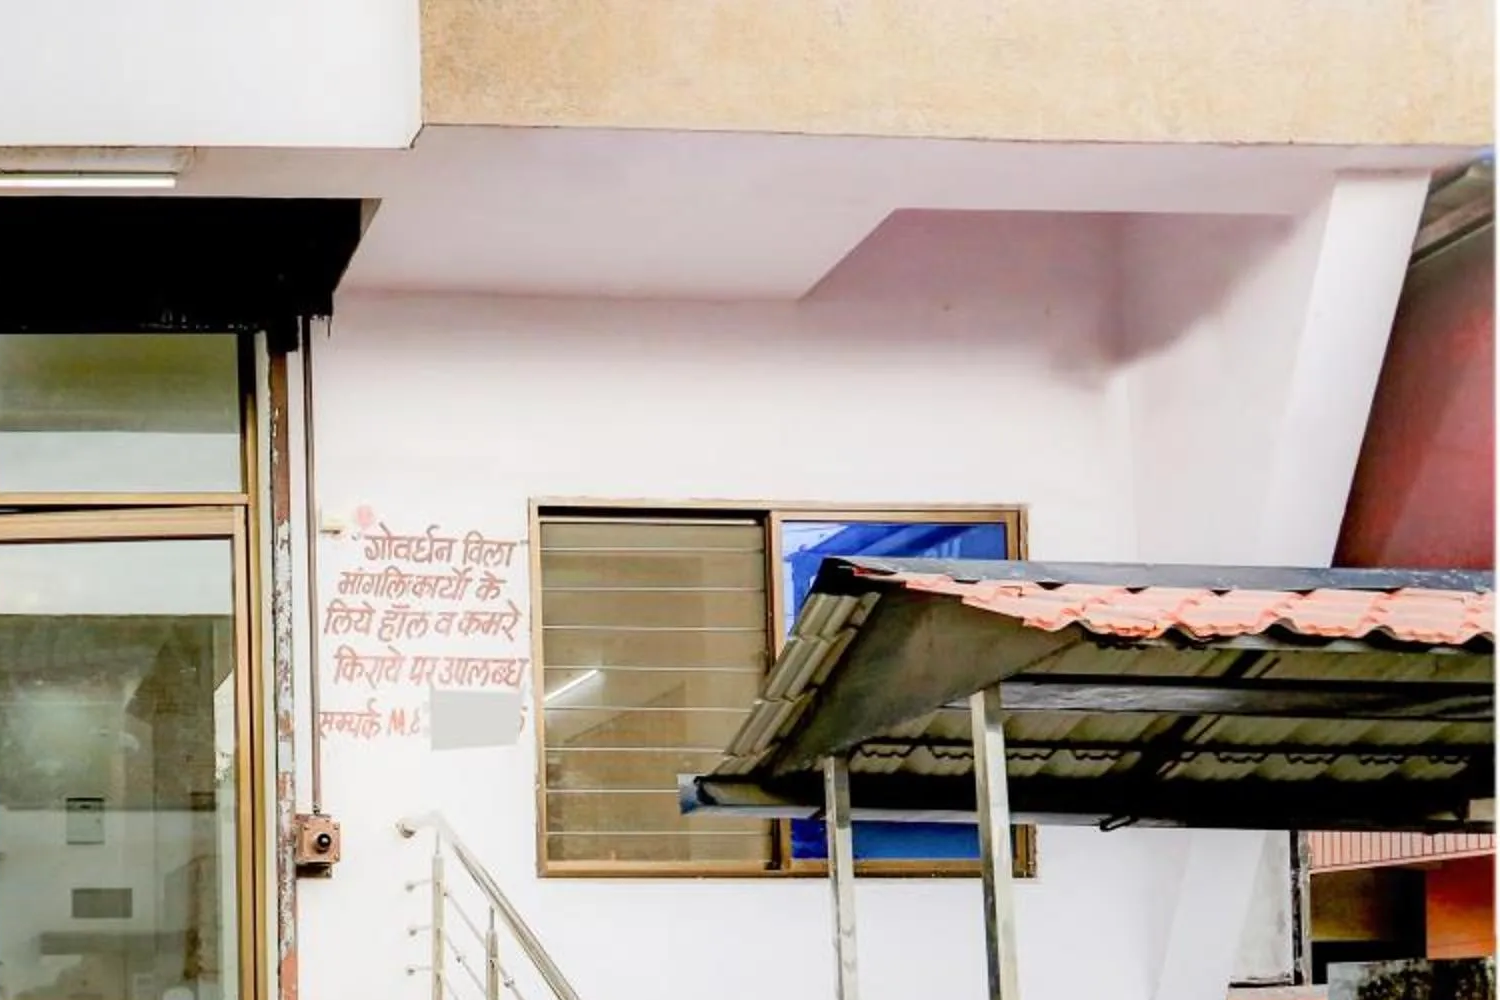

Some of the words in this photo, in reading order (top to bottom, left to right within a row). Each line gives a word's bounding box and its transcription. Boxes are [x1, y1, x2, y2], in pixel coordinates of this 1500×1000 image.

[364, 521, 459, 564] गोवर्धन
[462, 531, 518, 567] विला
[474, 571, 508, 600] के
[324, 598, 377, 636] लिये
[377, 604, 434, 642] हॉल
[458, 600, 523, 642] कमरे
[333, 645, 405, 689] किराये
[409, 656, 440, 686] पर
[437, 656, 531, 689] उपलब्ध
